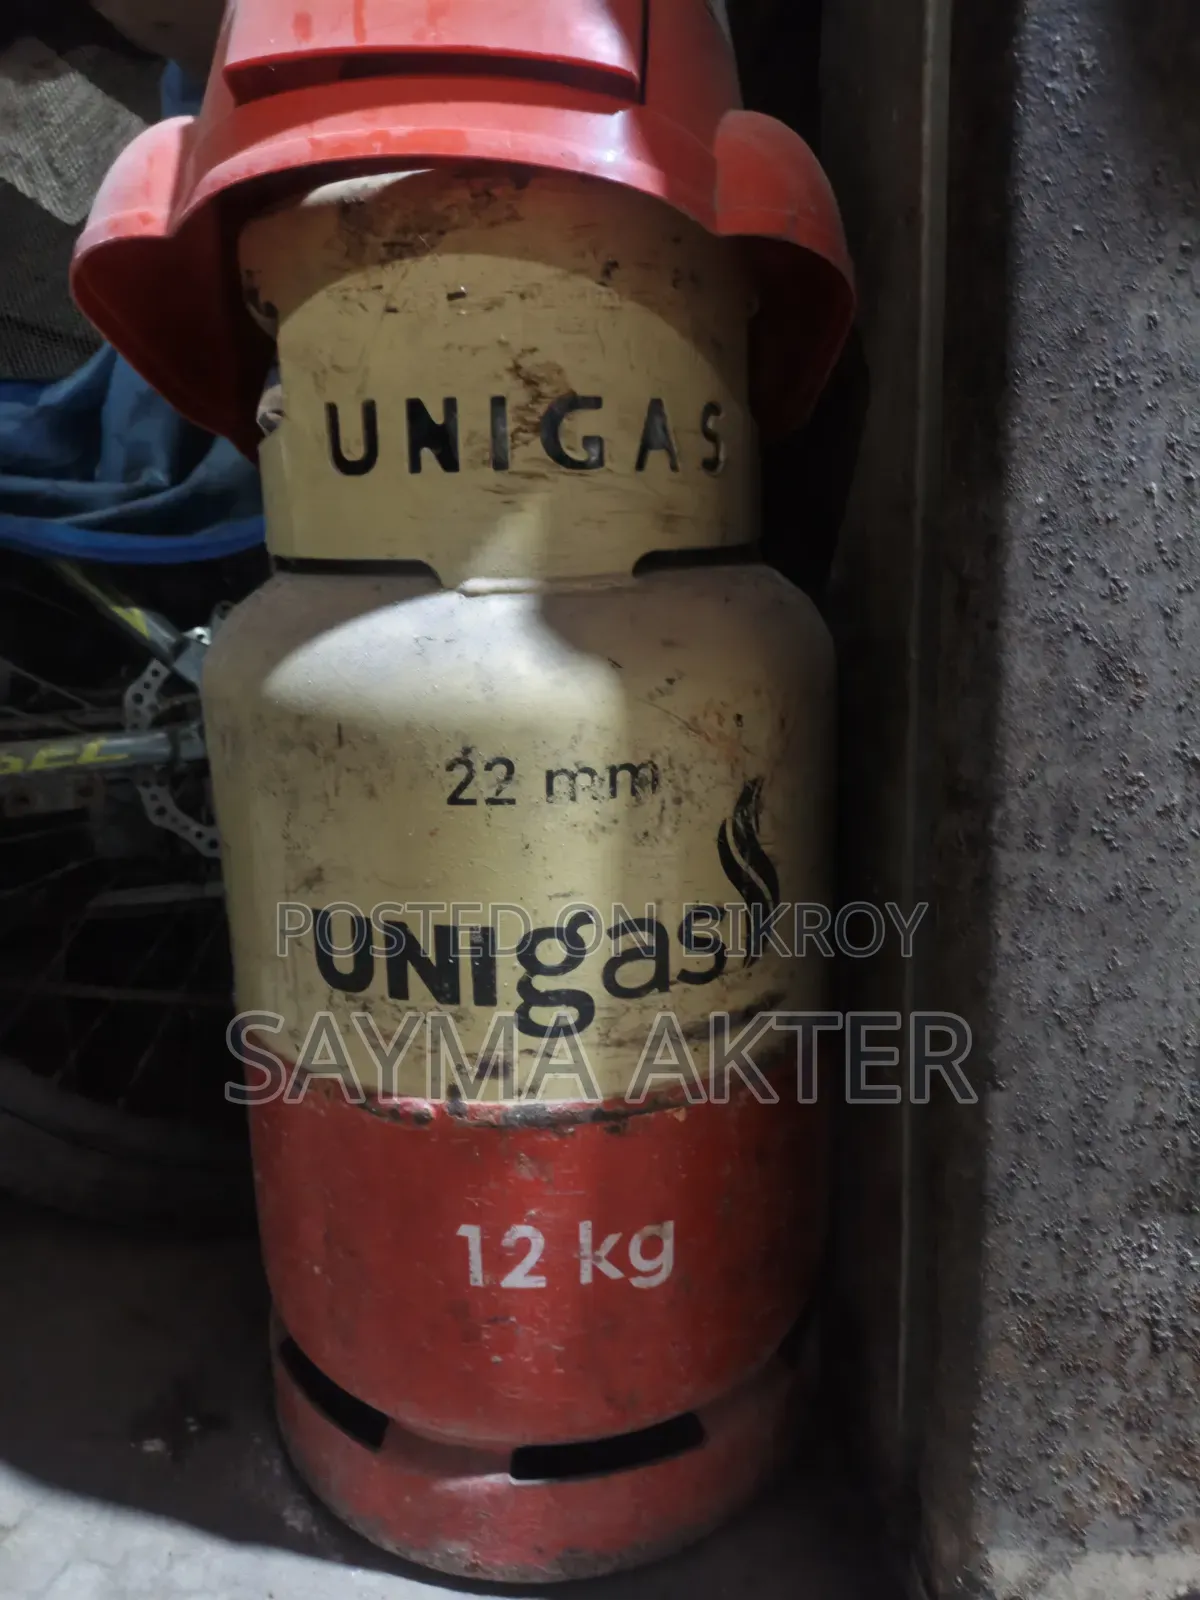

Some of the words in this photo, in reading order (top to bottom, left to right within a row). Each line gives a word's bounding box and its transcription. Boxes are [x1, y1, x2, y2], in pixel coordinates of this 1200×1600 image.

[325, 396, 728, 475] UNIGAS
[446, 754, 516, 806] 22
[546, 759, 659, 804] mm
[312, 905, 730, 1038] UNIgas
[456, 1223, 547, 1289] 12
[578, 1219, 676, 1288] kg
